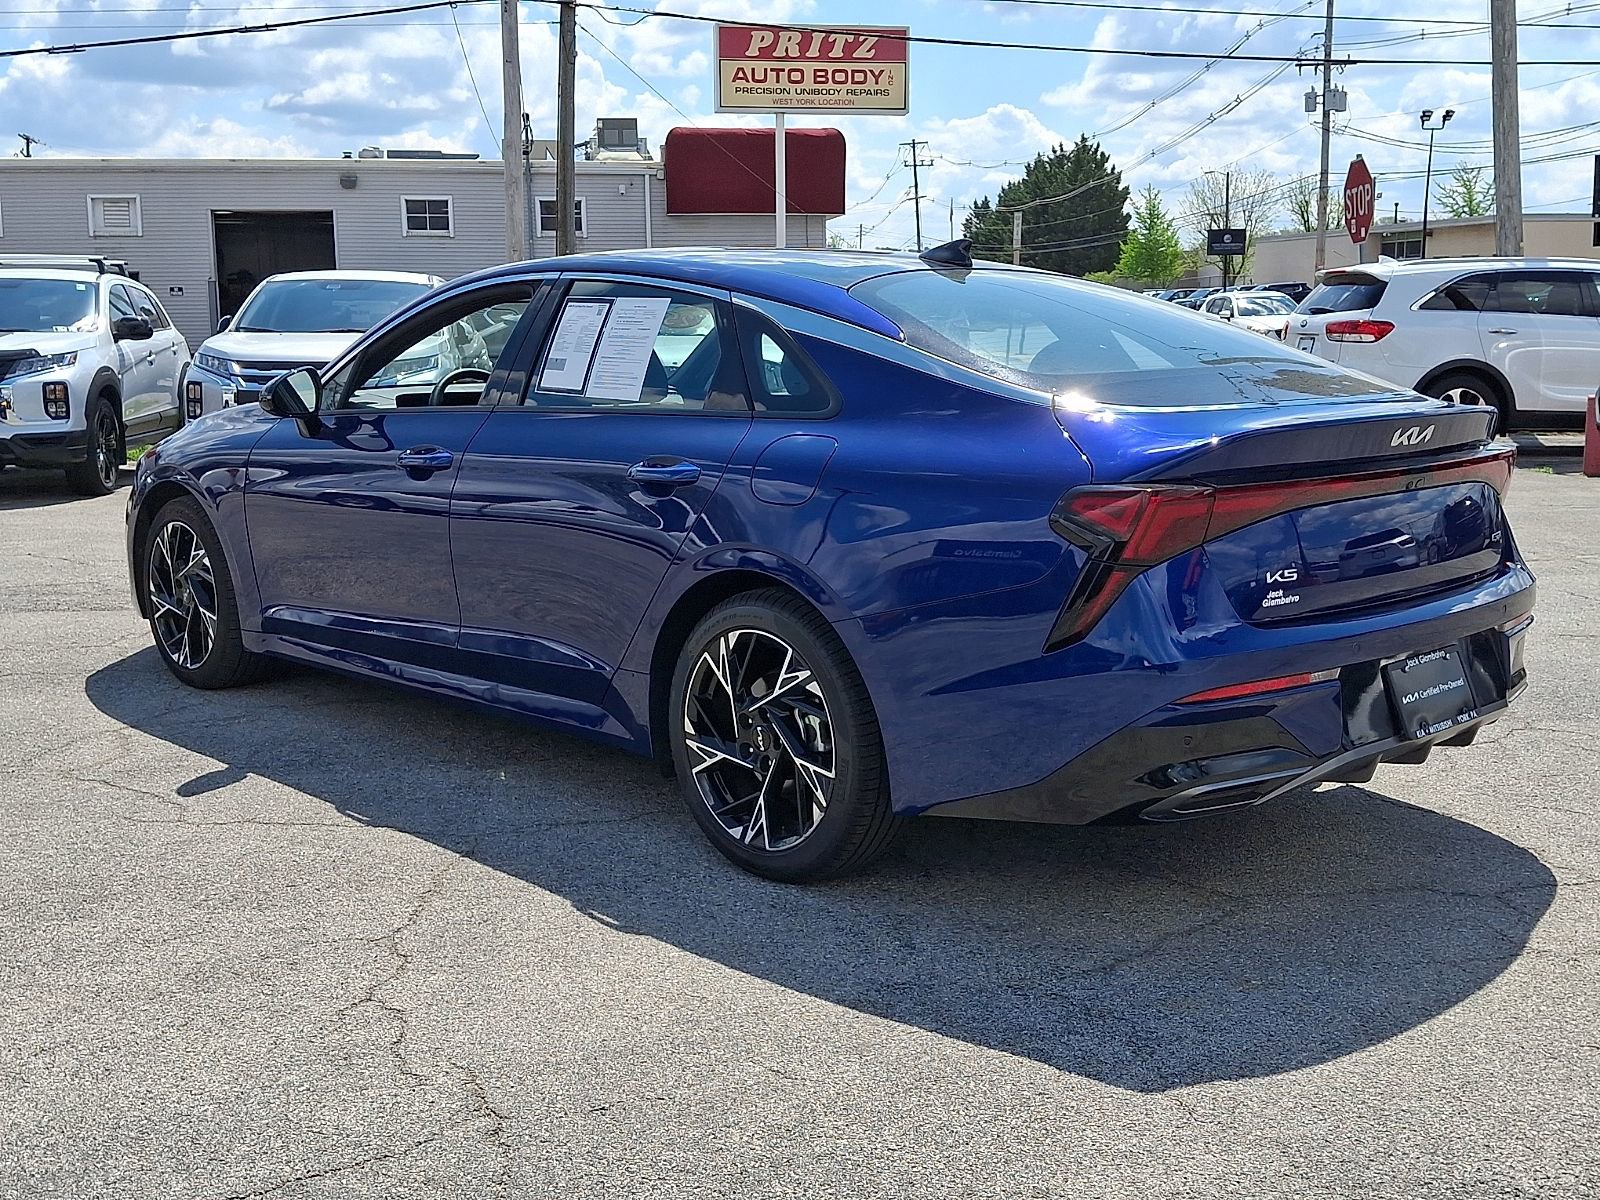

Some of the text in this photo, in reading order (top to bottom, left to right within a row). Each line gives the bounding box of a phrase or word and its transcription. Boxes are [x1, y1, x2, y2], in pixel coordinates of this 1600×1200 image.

[745, 30, 880, 59] PRITZ
[731, 66, 885, 85] AUTO BODY
[735, 87, 890, 97] PRECISION UNIBODY REPAIRS
[795, 98, 816, 106] YORK
[1345, 183, 1372, 220] STOP
[1390, 424, 1435, 447] KIA
[1266, 569, 1298, 583] K5
[1266, 589, 1283, 598] Jack
[1262, 595, 1300, 607] Giambalvo
[1406, 656, 1419, 667] Jack
[1420, 686, 1440, 698] Certified
